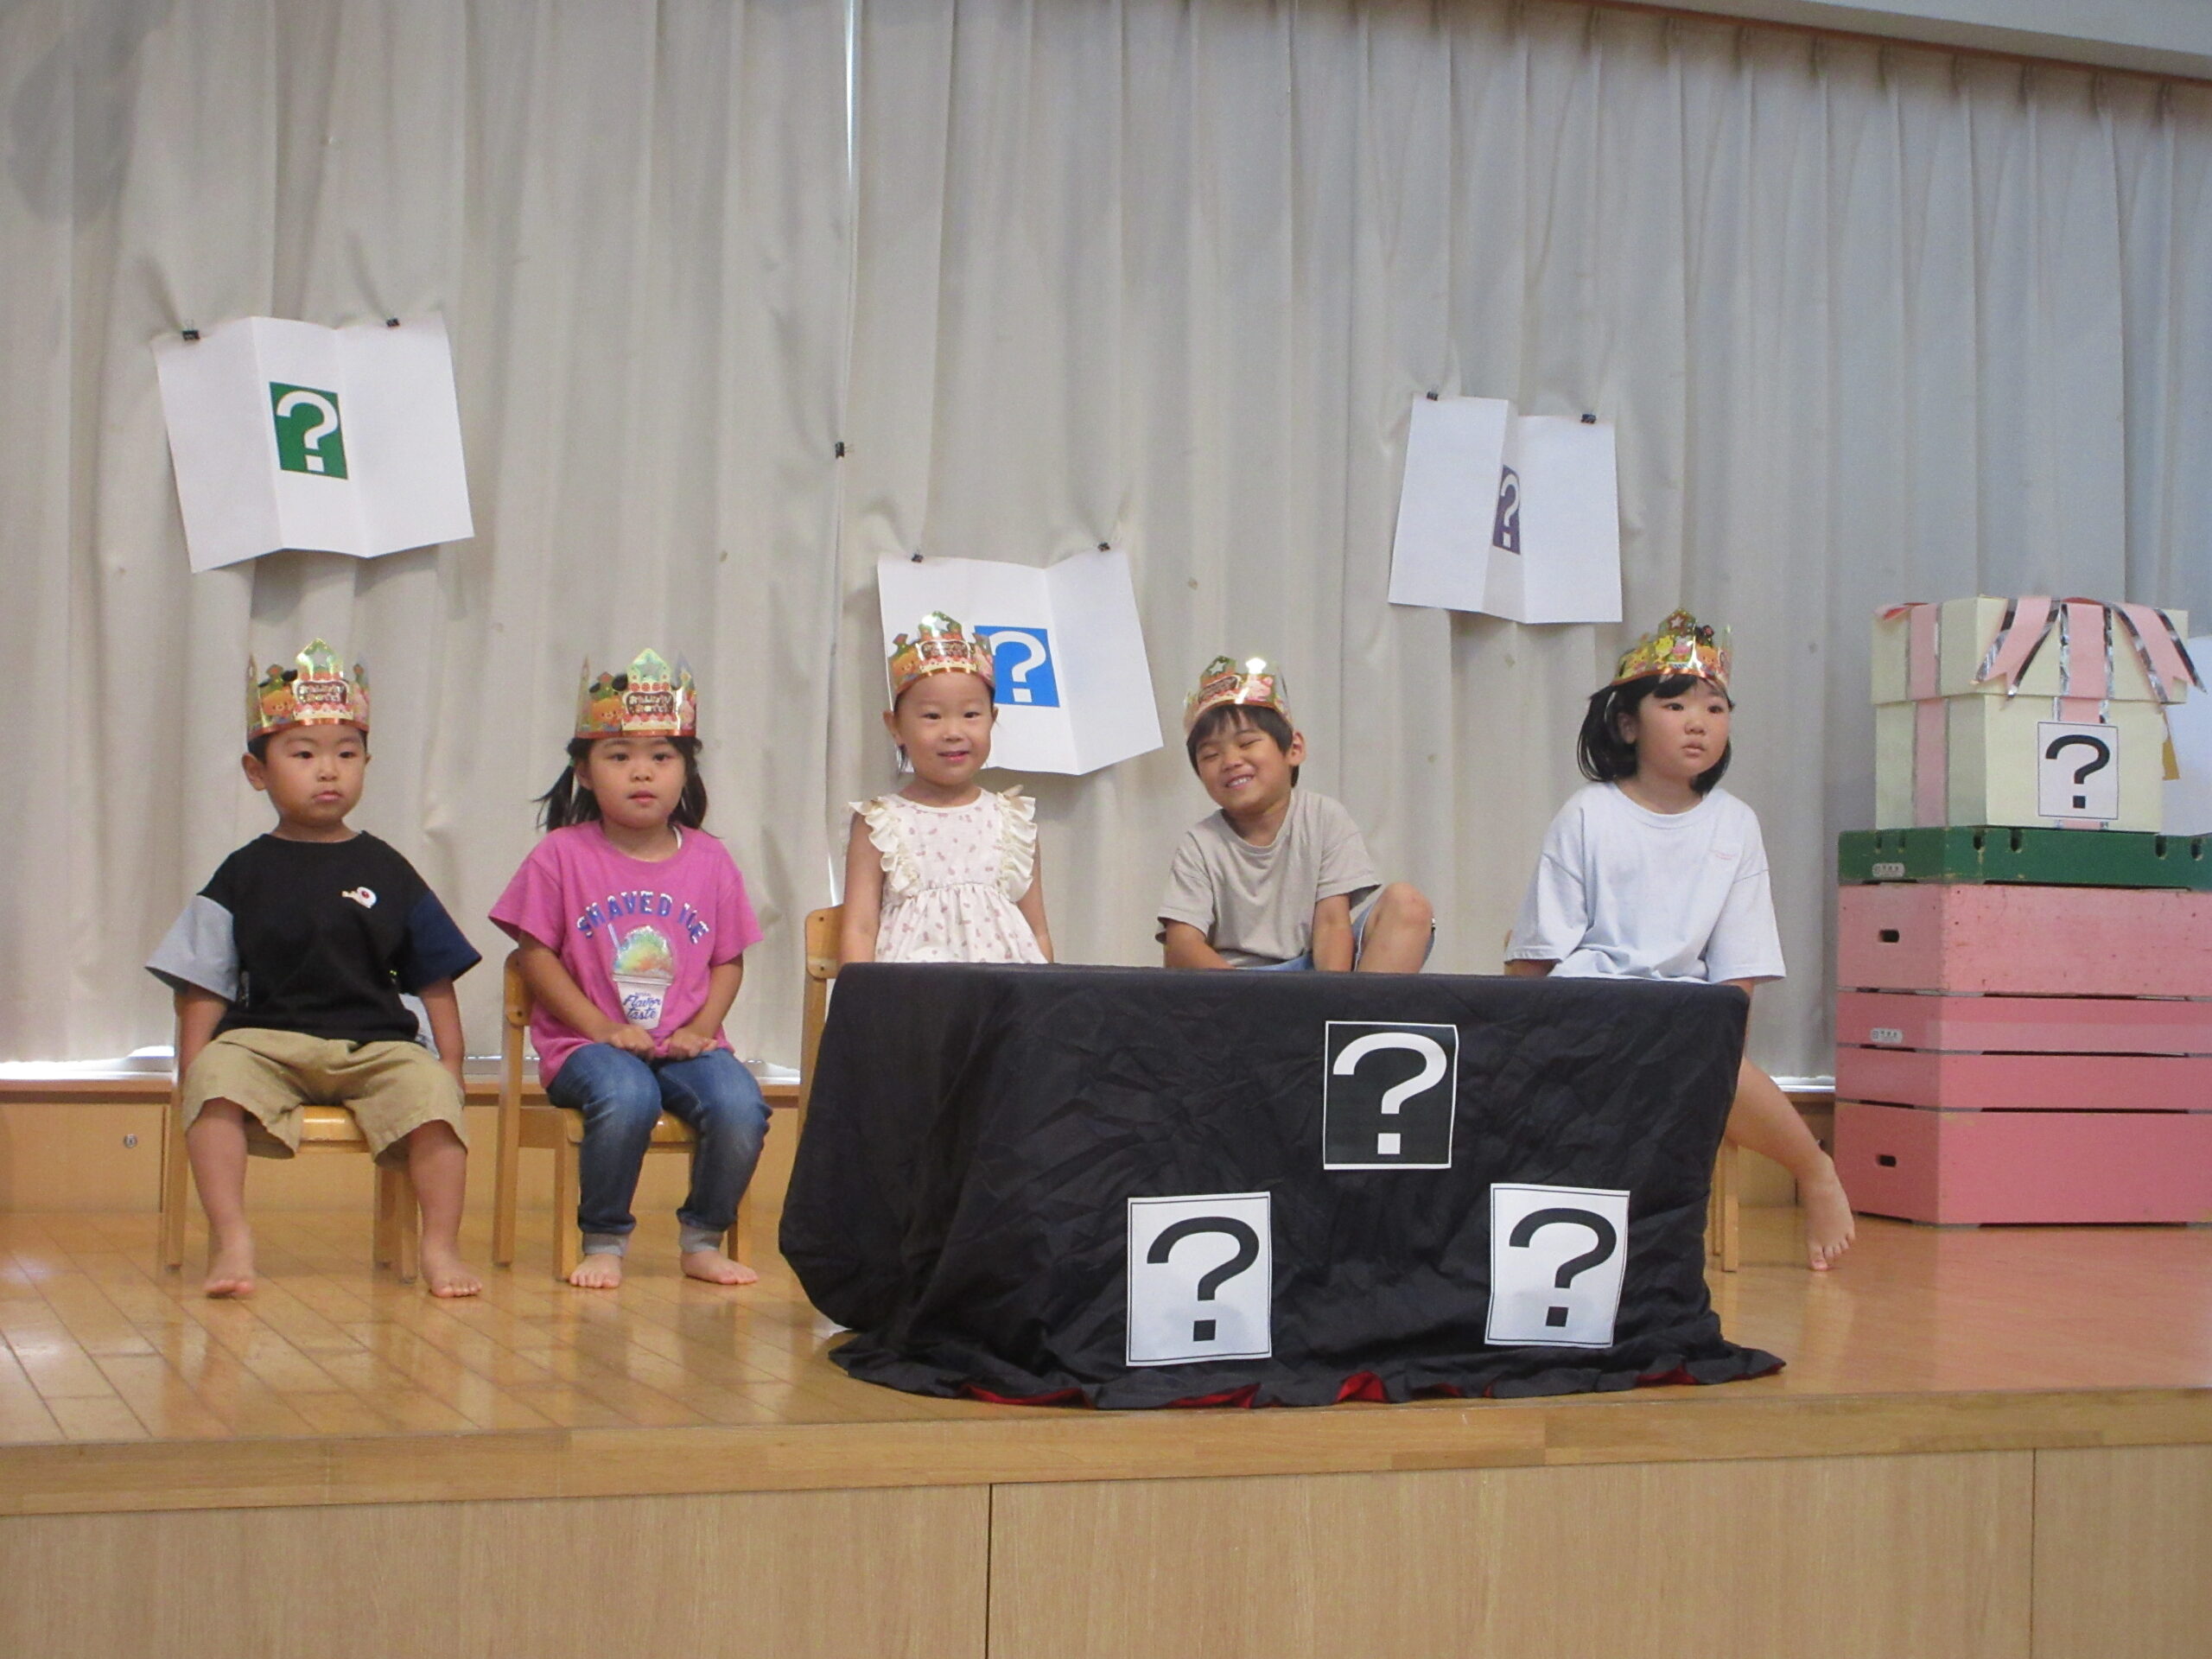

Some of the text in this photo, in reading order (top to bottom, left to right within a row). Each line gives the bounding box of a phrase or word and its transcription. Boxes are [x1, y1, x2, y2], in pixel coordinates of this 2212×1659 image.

[276, 391, 338, 473] ?
[1501, 474, 1521, 548] ?
[989, 630, 1046, 703] ?
[2045, 734, 2110, 809] ?
[576, 890, 709, 944] SHAVED ICE
[1332, 1032, 1447, 1154] ?
[1147, 1216, 1260, 1342] ?
[1509, 1207, 1618, 1327] ?
